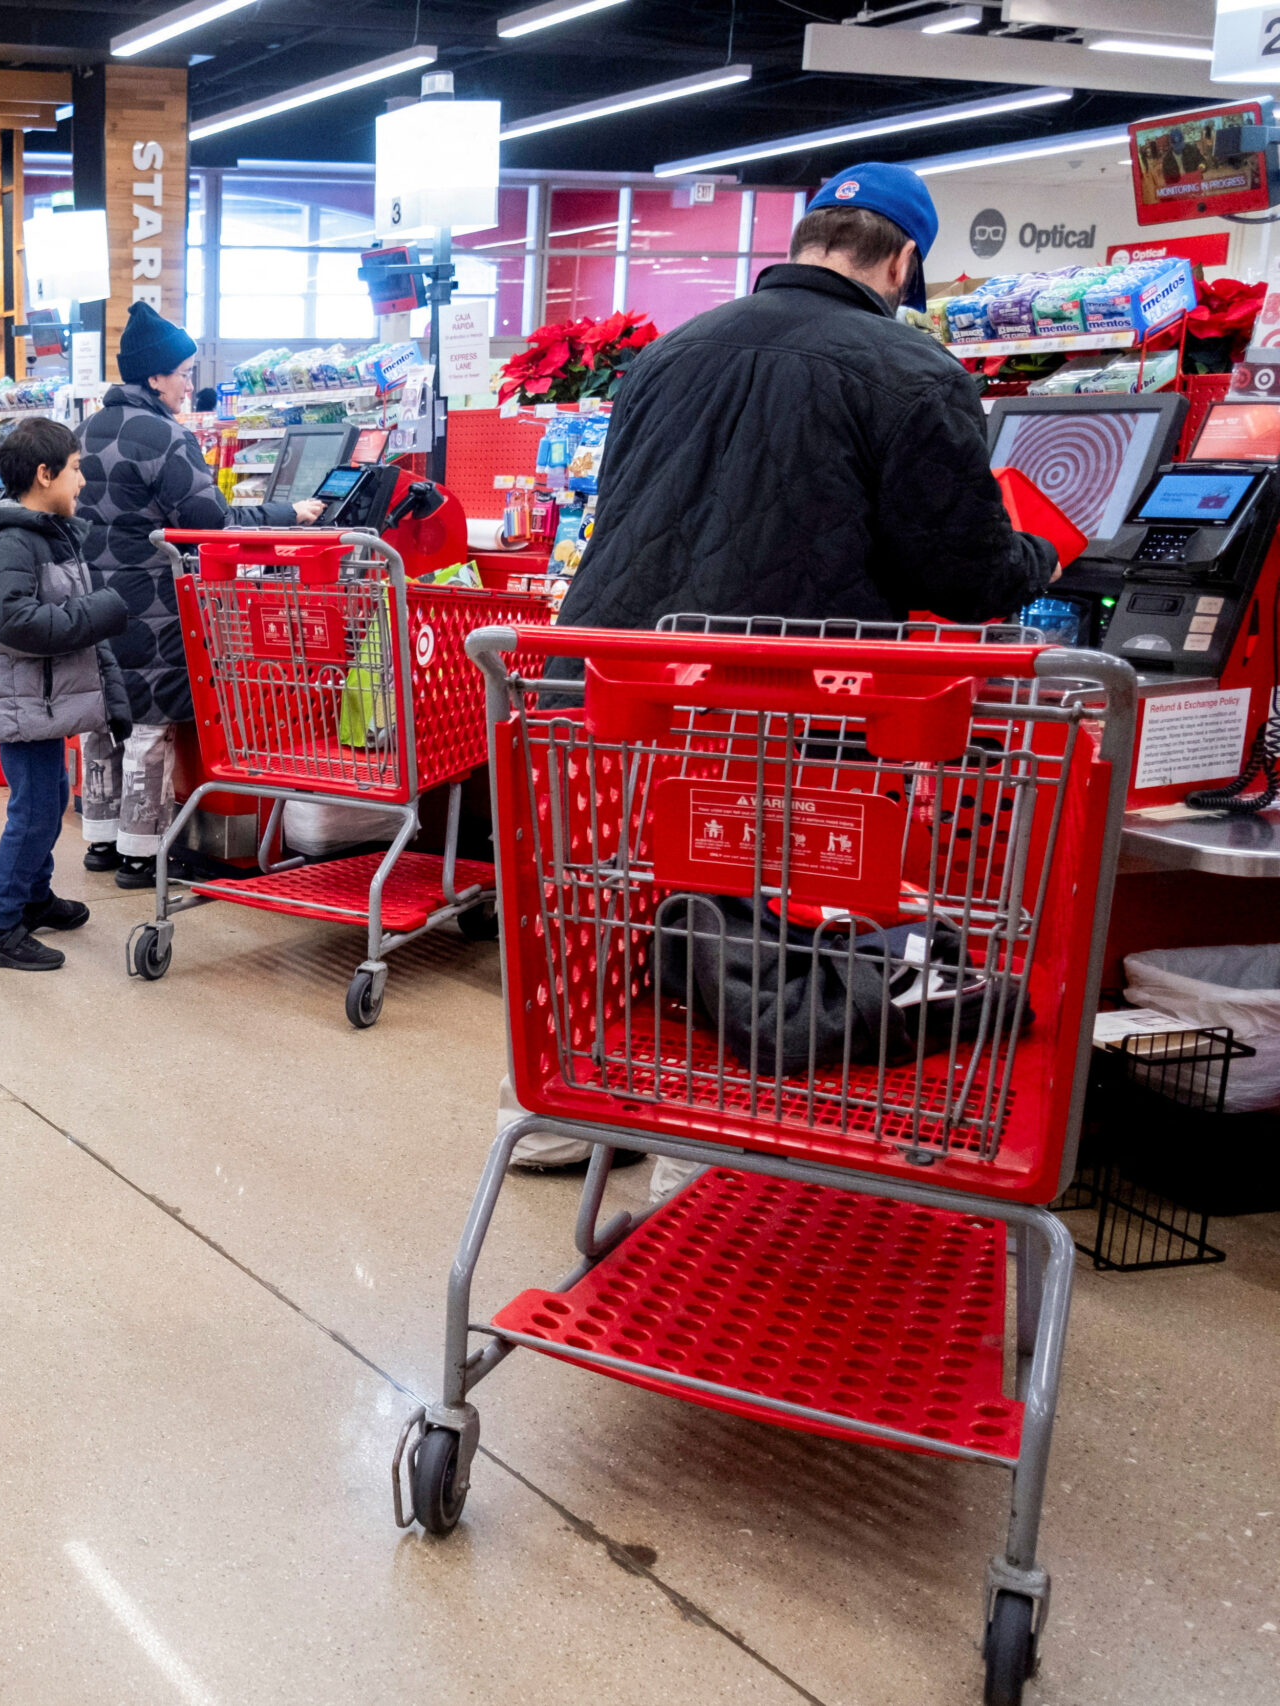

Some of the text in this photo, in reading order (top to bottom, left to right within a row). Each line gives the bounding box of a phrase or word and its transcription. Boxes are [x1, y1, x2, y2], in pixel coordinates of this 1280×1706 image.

[1156, 175, 1245, 197] MONITORING IN PROGRESS
[392, 202, 401, 225] 3
[1019, 221, 1096, 253] Optical
[1132, 247, 1167, 261] Optical
[1142, 274, 1185, 313] mentos
[455, 313, 471, 322] CAJA
[1087, 318, 1132, 329] mentos
[1038, 323, 1080, 333] mentos
[383, 350, 415, 374] mentos
[450, 352, 478, 362] EXPRESS
[455, 362, 472, 371] LANE
[1150, 696, 1239, 713] Refund & Exchange Policy
[750, 797, 816, 812] WARING
